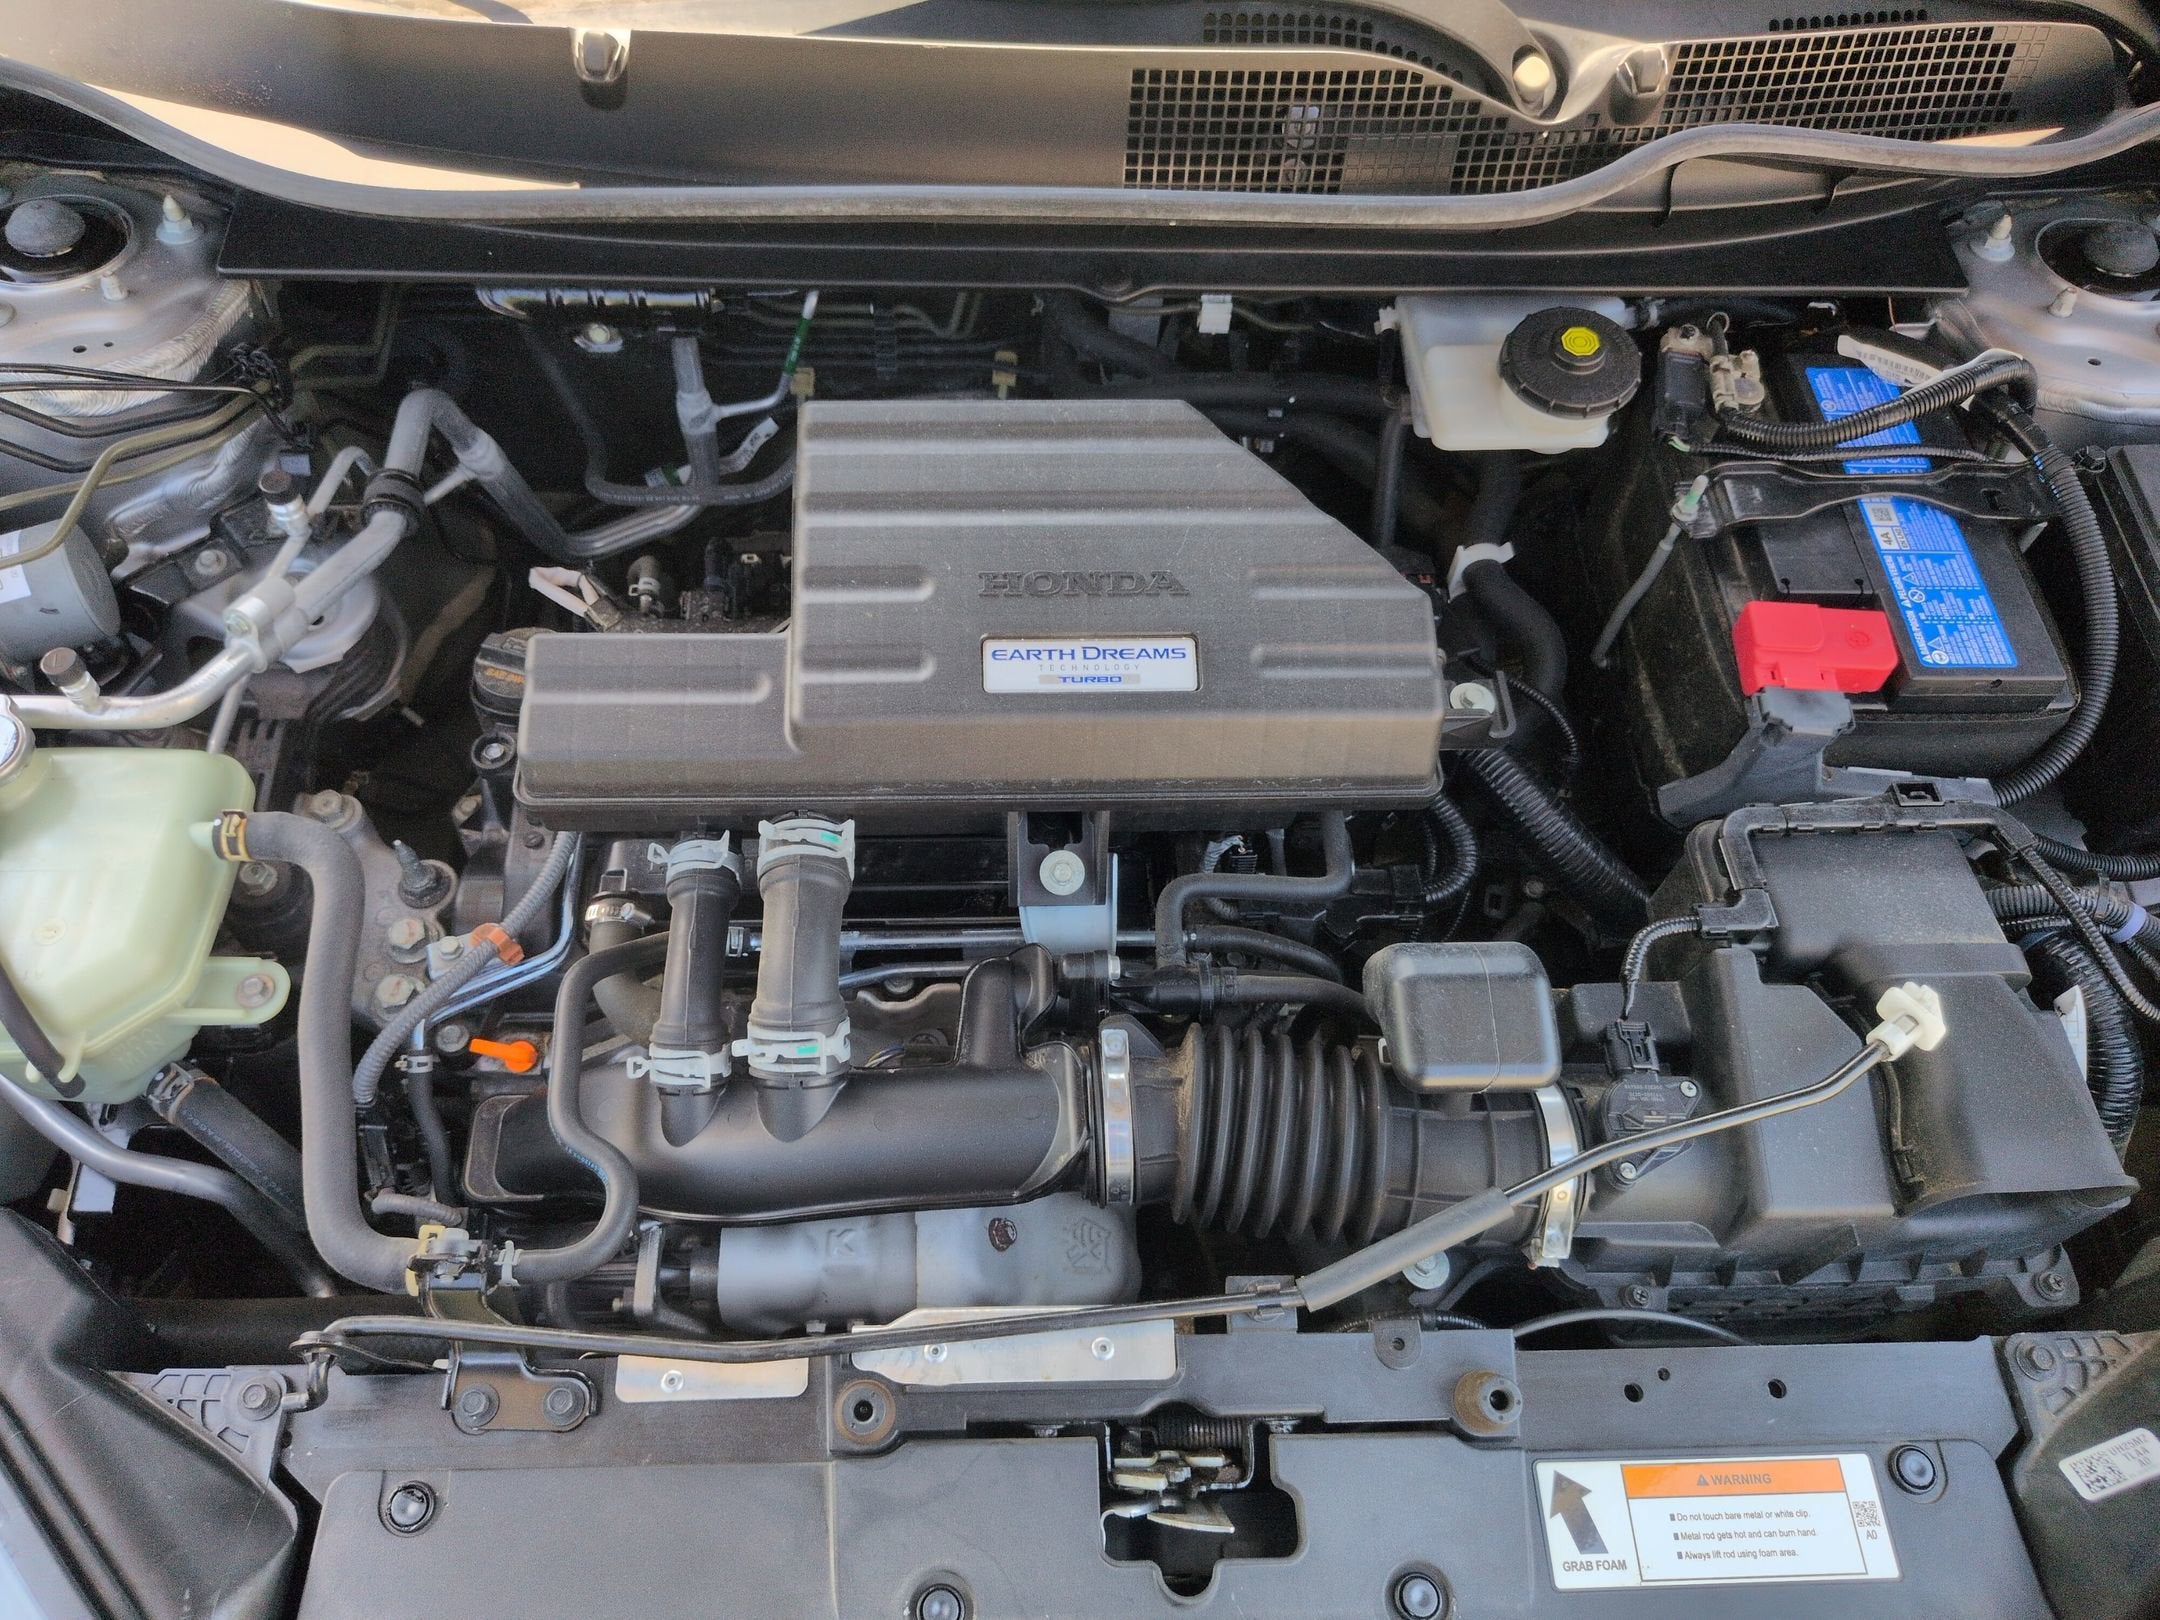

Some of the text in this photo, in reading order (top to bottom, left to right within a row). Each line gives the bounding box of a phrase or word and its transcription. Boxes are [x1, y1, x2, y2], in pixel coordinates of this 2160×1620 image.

[1879, 531, 1893, 546] 4A
[978, 571, 1190, 598] HONDA
[991, 646, 1187, 661] EARTH DREAMS
[1039, 663, 1141, 672] TECHNOLOGY
[1058, 675, 1123, 684] TURBO
[1711, 1473, 1772, 1486] WARNING
[1676, 1513, 1688, 1522] Do
[1690, 1512, 1702, 1521] not
[1702, 1511, 1724, 1520] touch
[1725, 1510, 1742, 1520] bare
[1744, 1510, 1764, 1520] metal
[1775, 1509, 1794, 1518] white
[1796, 1509, 1811, 1520] clip.
[1680, 1528, 1818, 1542] Metal rod gets hot and can burn hand.
[1866, 1530, 1878, 1540] A0
[1684, 1548, 1799, 1561] Always lift rod using foam area.
[1562, 1559, 1628, 1572] GRAB FOAM
